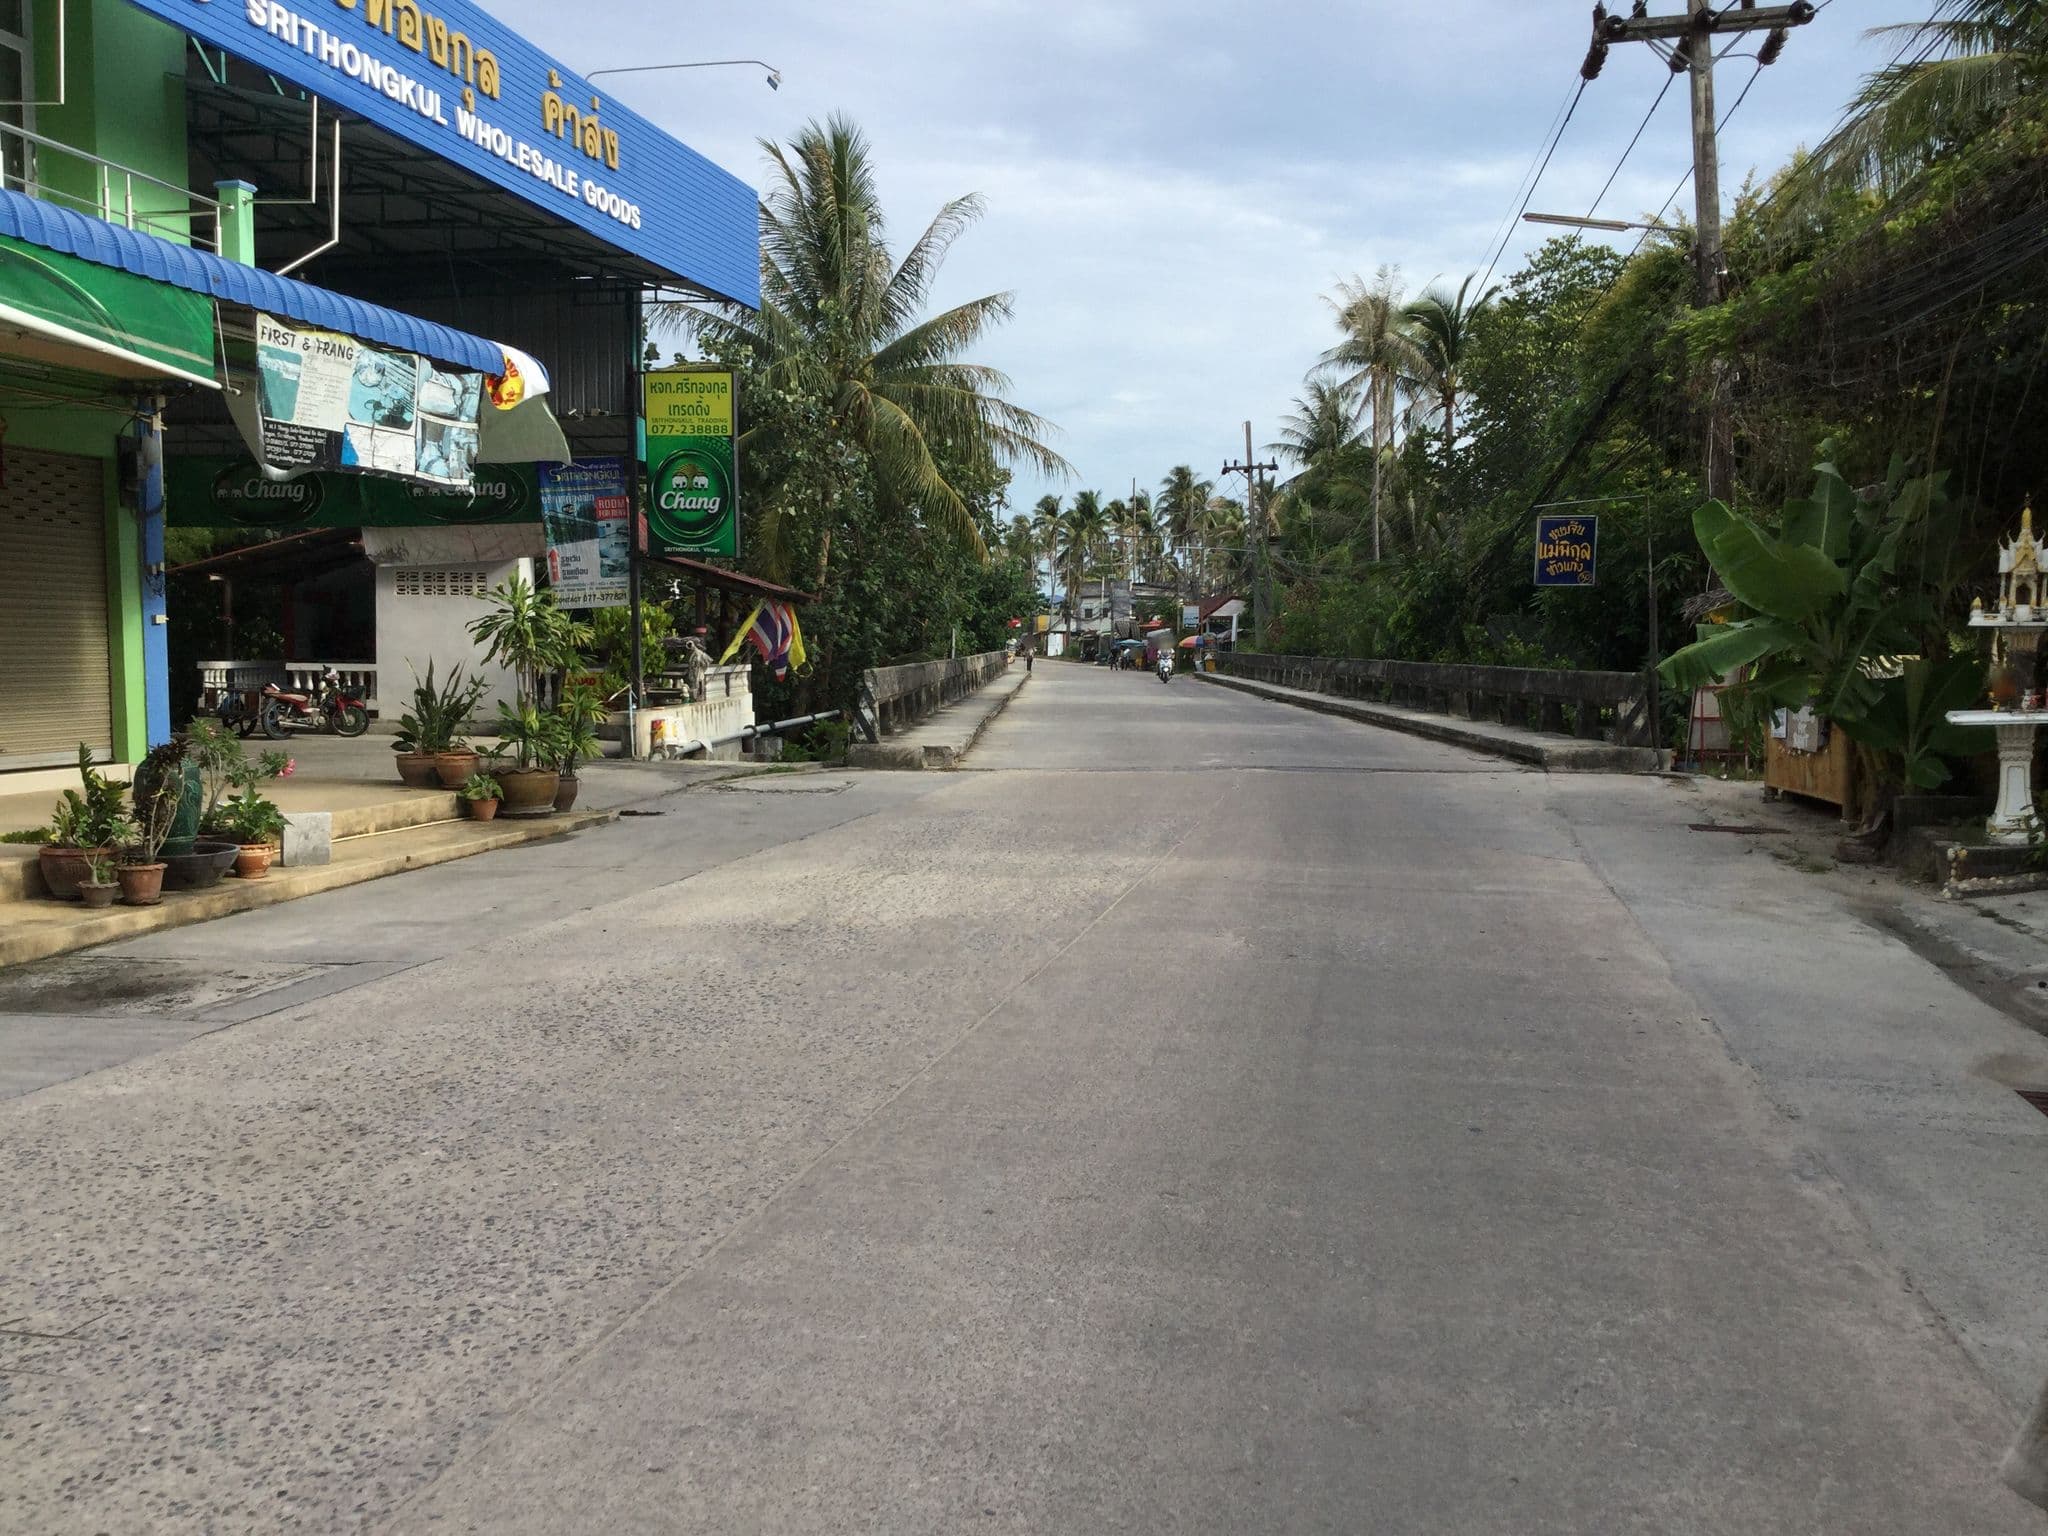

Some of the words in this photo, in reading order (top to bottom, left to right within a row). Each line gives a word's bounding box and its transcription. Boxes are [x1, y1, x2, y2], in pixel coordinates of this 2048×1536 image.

[337, 0, 501, 113] ทองกุล
[541, 68, 620, 170] ค้าส่ง
[246, 0, 448, 127] SRITHONGKUL
[455, 105, 579, 198] WHOLESALE
[582, 180, 641, 230] GOODS
[260, 325, 297, 348] FIRST
[302, 337, 311, 351] &
[650, 378, 728, 400] หจก.ศรีทองกุล
[668, 395, 710, 416] เทรดดิ้ง
[651, 424, 728, 434] 077-238888
[244, 478, 305, 502] Chang
[598, 499, 625, 508] ROOM
[659, 491, 721, 513] Chang
